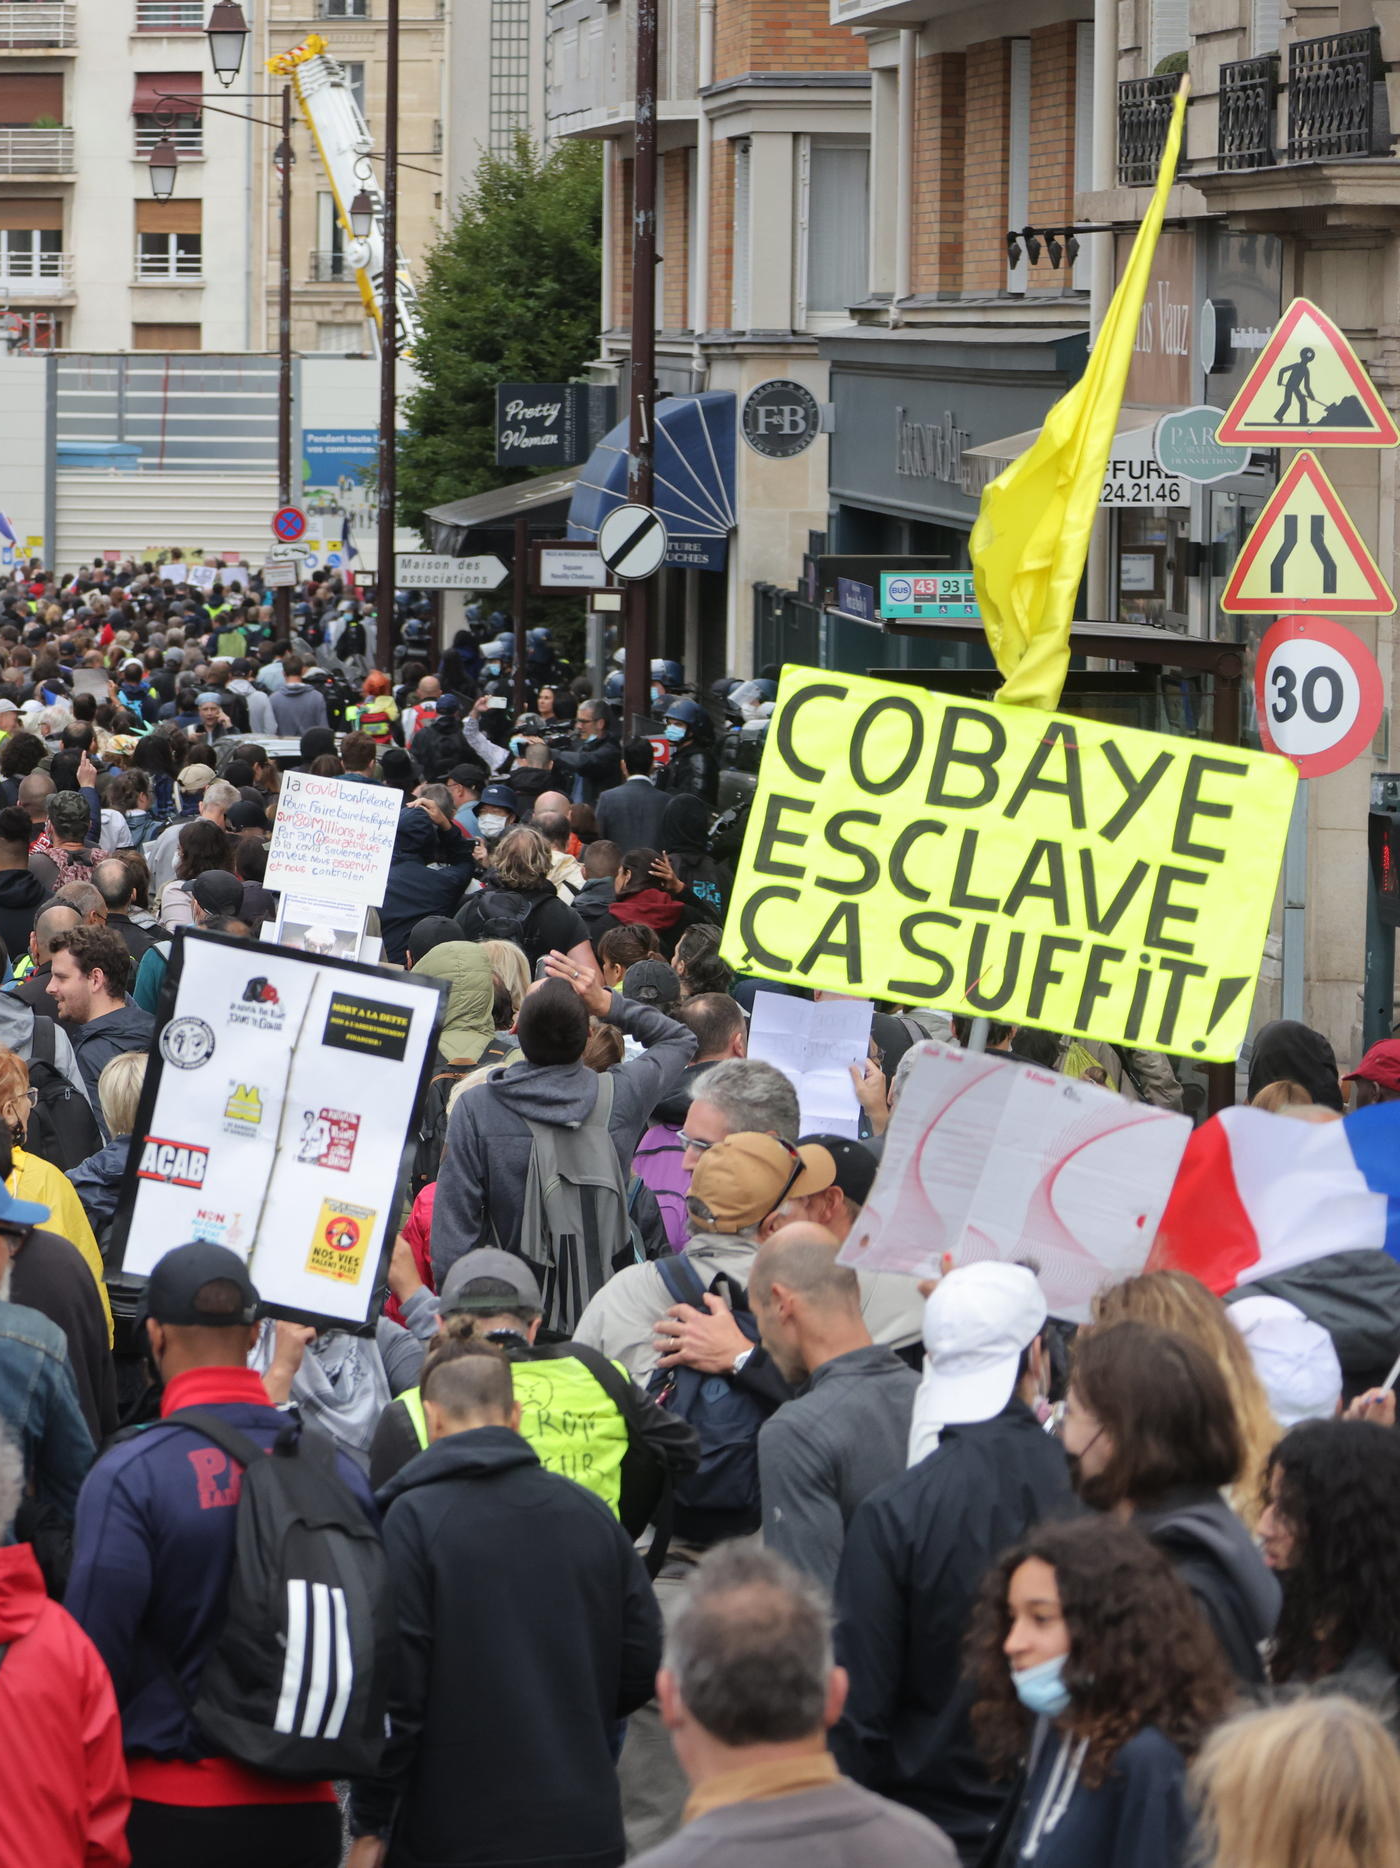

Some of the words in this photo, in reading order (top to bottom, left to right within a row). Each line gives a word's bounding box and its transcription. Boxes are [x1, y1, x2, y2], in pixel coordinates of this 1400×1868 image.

[505, 400, 561, 427] Pretty
[500, 425, 559, 451] Woman
[667, 542, 702, 552] TURE
[401, 559, 450, 570] Maison
[458, 558, 481, 570] des
[665, 553, 710, 564] UCHES
[401, 573, 488, 585] associations
[916, 580, 935, 593] 43
[942, 580, 960, 593] 93
[1271, 665, 1344, 723] 30
[777, 684, 1249, 863] COBAYE
[286, 776, 301, 792] la
[305, 782, 339, 798] covid
[296, 842, 321, 853] covid
[753, 793, 1208, 954] ESCLAVE
[738, 885, 862, 985] ÇA
[366, 1010, 378, 1020] LA
[379, 1012, 408, 1026] DETTE
[139, 1142, 207, 1182] ACAB
[313, 1247, 333, 1260] NOS
[339, 1253, 360, 1267] VIES
